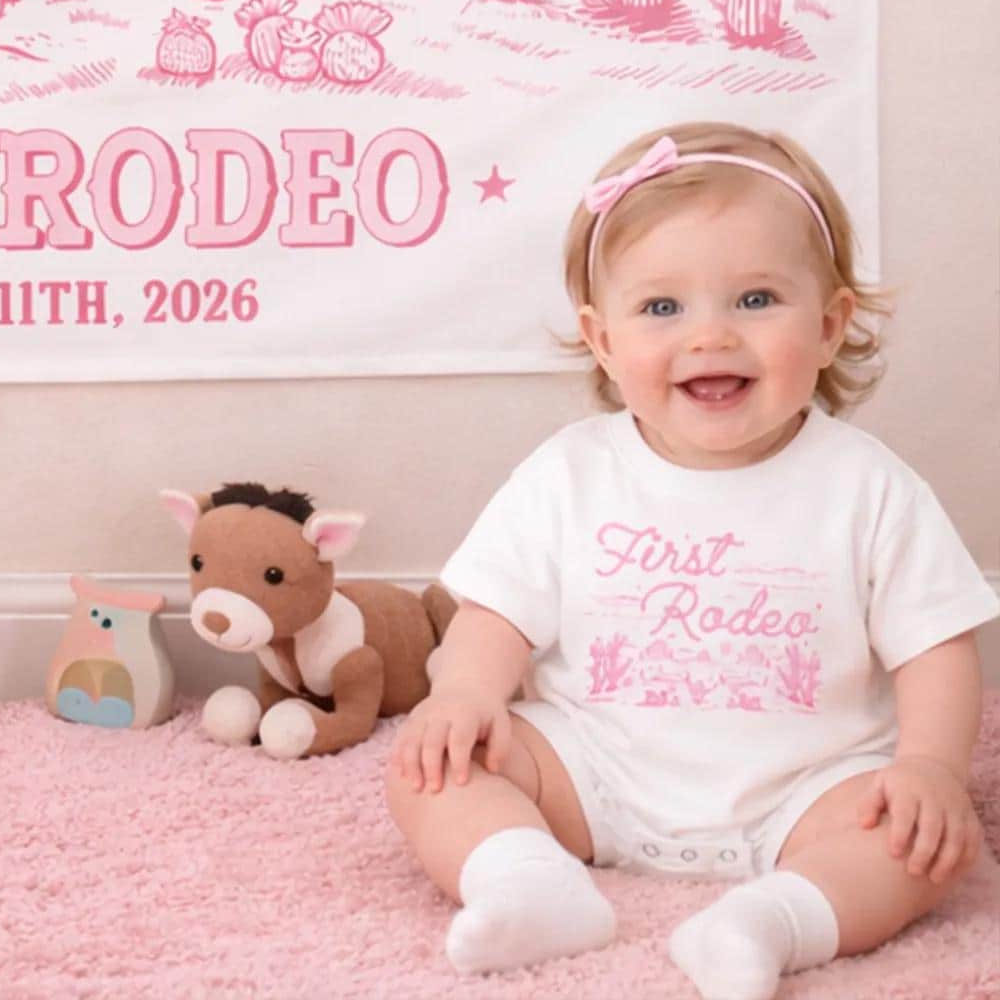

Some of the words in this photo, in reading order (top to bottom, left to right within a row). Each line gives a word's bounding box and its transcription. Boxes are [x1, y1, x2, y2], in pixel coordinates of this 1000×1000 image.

[142, 277, 261, 326] 2026
[595, 522, 745, 577] First
[640, 581, 819, 642] Rodeo
